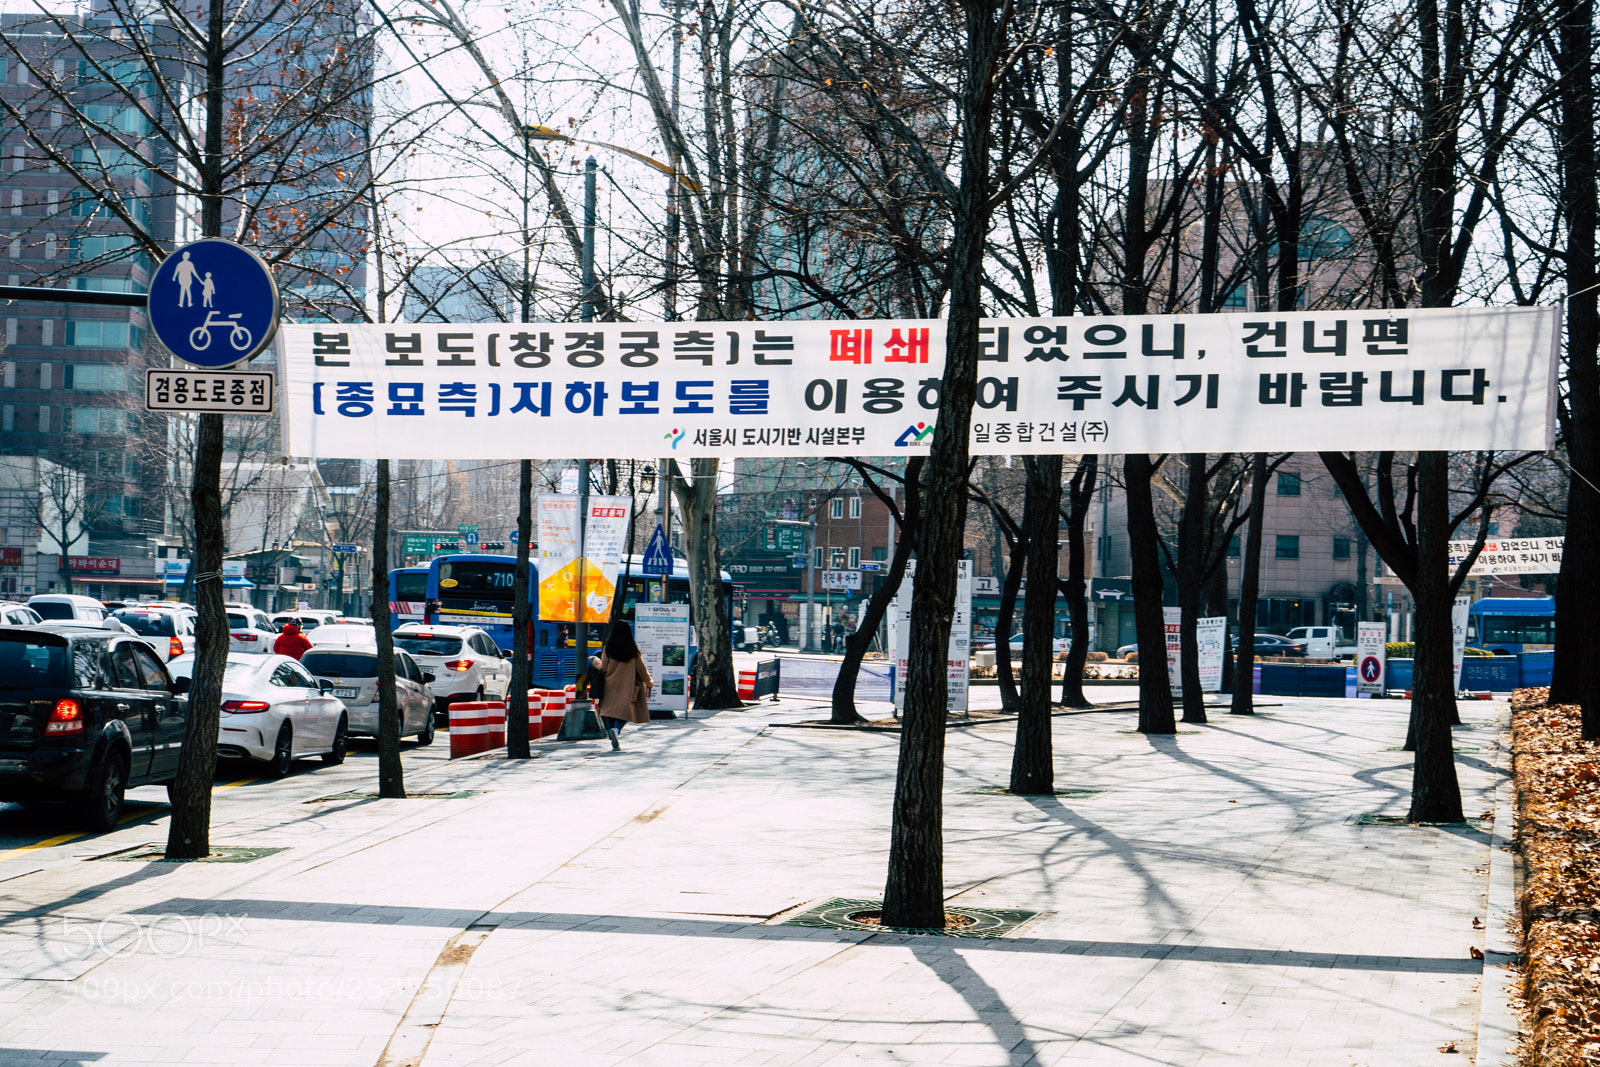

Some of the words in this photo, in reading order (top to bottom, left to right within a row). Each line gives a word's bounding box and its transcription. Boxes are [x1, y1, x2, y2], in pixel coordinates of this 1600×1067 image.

[312, 332, 351, 367] 본
[385, 330, 794, 368] 보도(창경궁측)는
[829, 328, 930, 366] 폐쇄
[977, 323, 1206, 363] 되었으니,
[1241, 317, 1411, 358] 건너편
[155, 376, 265, 406] 겸용도로종점
[312, 379, 771, 418] (종묘측)지하보도를
[804, 376, 1019, 415] 이용하여
[1057, 373, 1220, 411] 주시기
[1259, 367, 1507, 408] 바랍니다.
[693, 427, 737, 447] 서울시
[742, 427, 802, 446] 도시기반
[805, 426, 866, 446] 시설본부
[494, 572, 514, 588] 710
